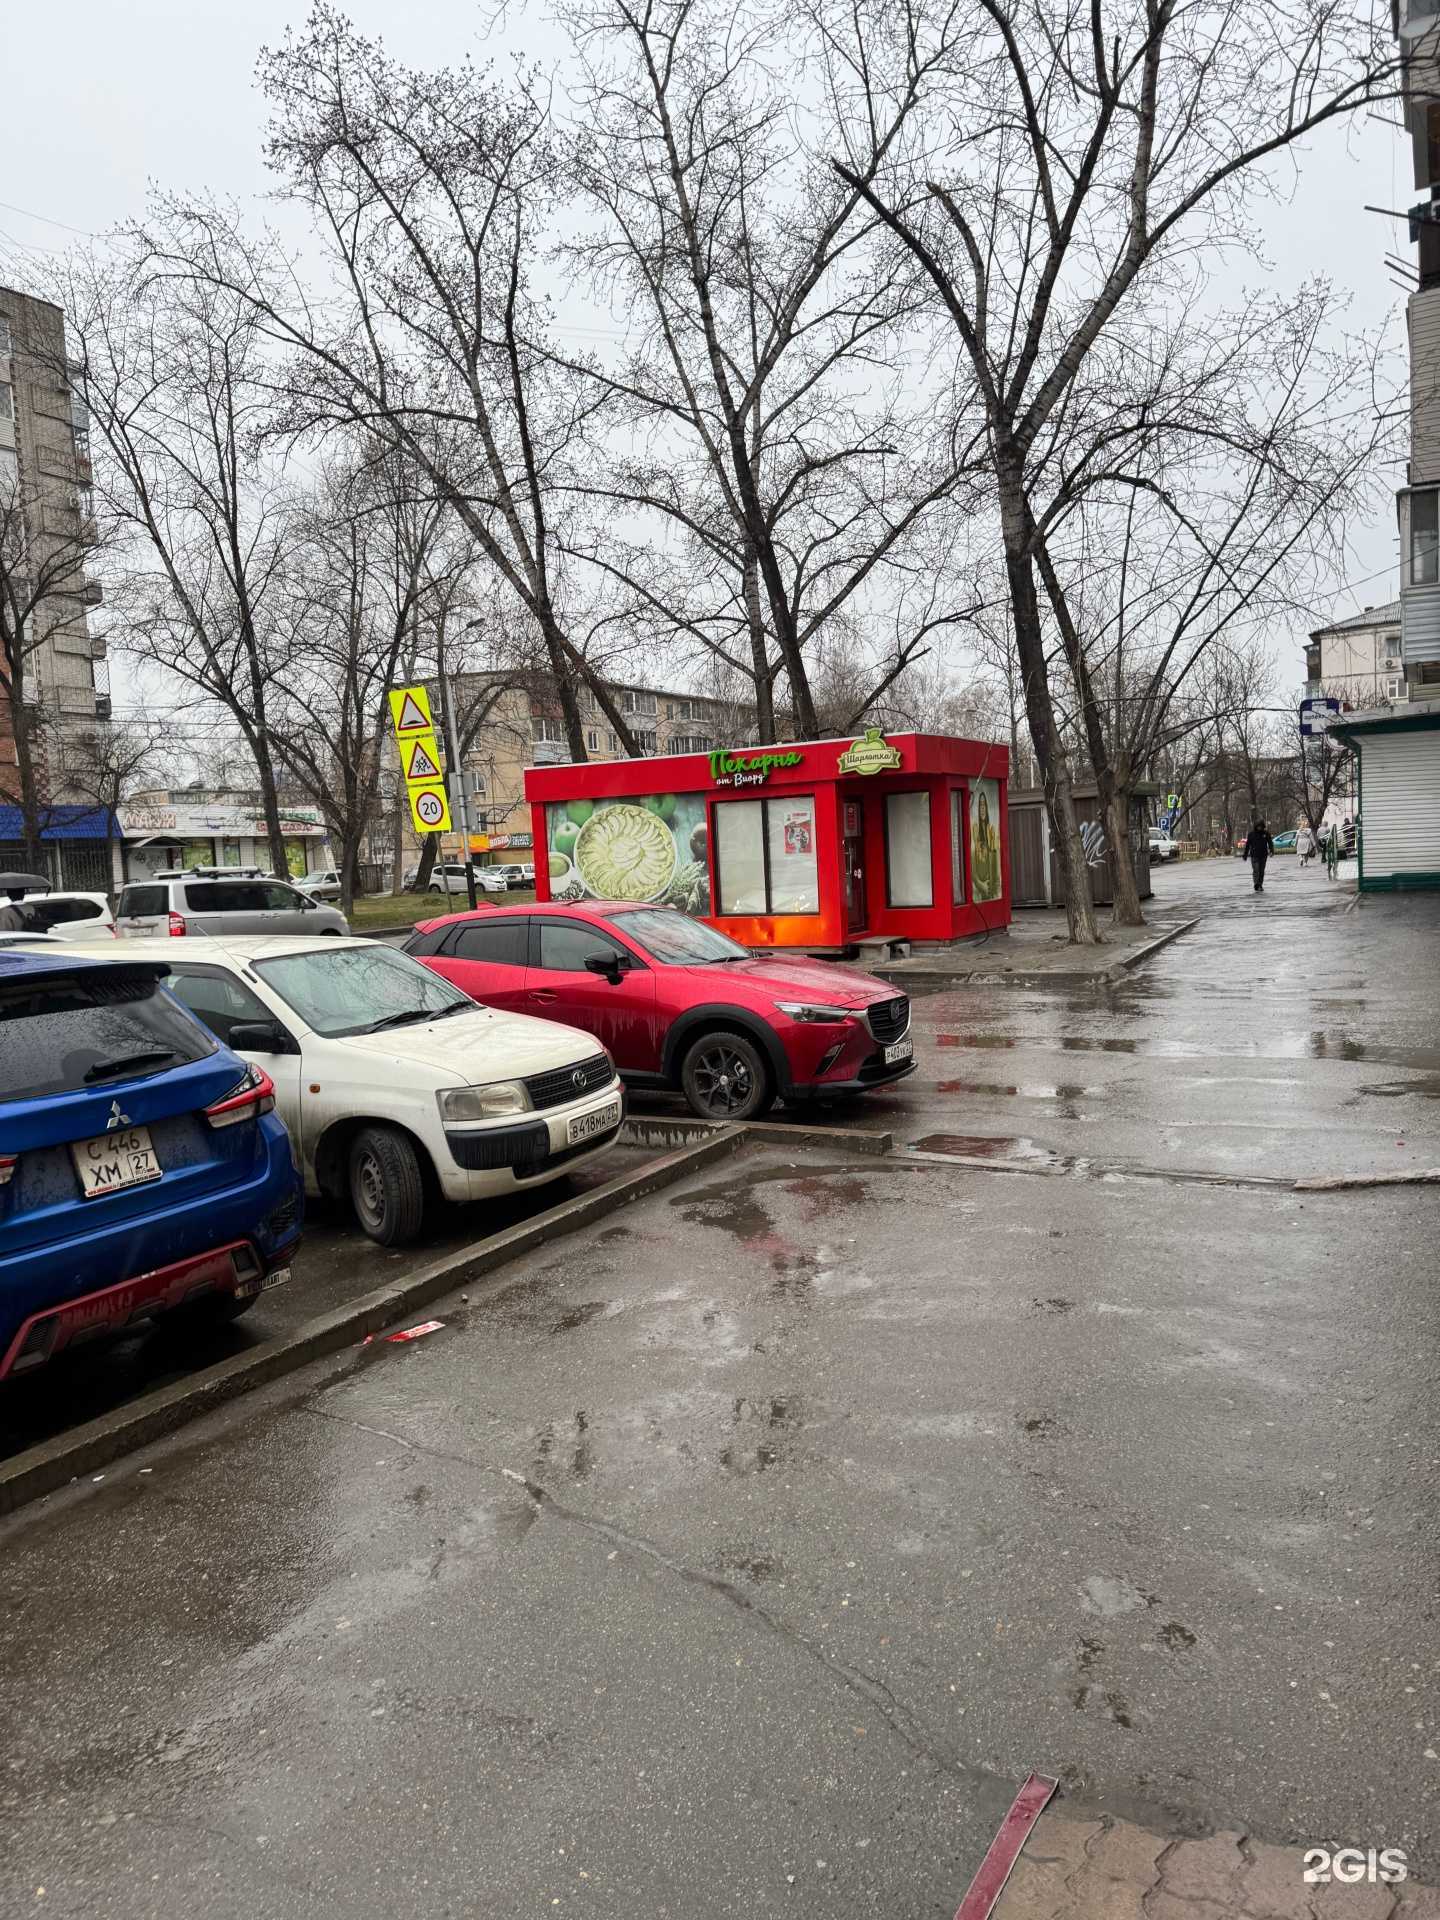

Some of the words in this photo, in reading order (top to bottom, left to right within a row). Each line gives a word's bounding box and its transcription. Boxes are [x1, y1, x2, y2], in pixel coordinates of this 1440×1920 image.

[710, 750, 802, 778] Пекарня
[847, 752, 891, 763] Шарлотка
[423, 802, 437, 815] 20
[88, 1142, 101, 1159] С
[108, 1132, 140, 1155] 446
[133, 1153, 148, 1169] 27
[90, 1161, 121, 1186] ХМ
